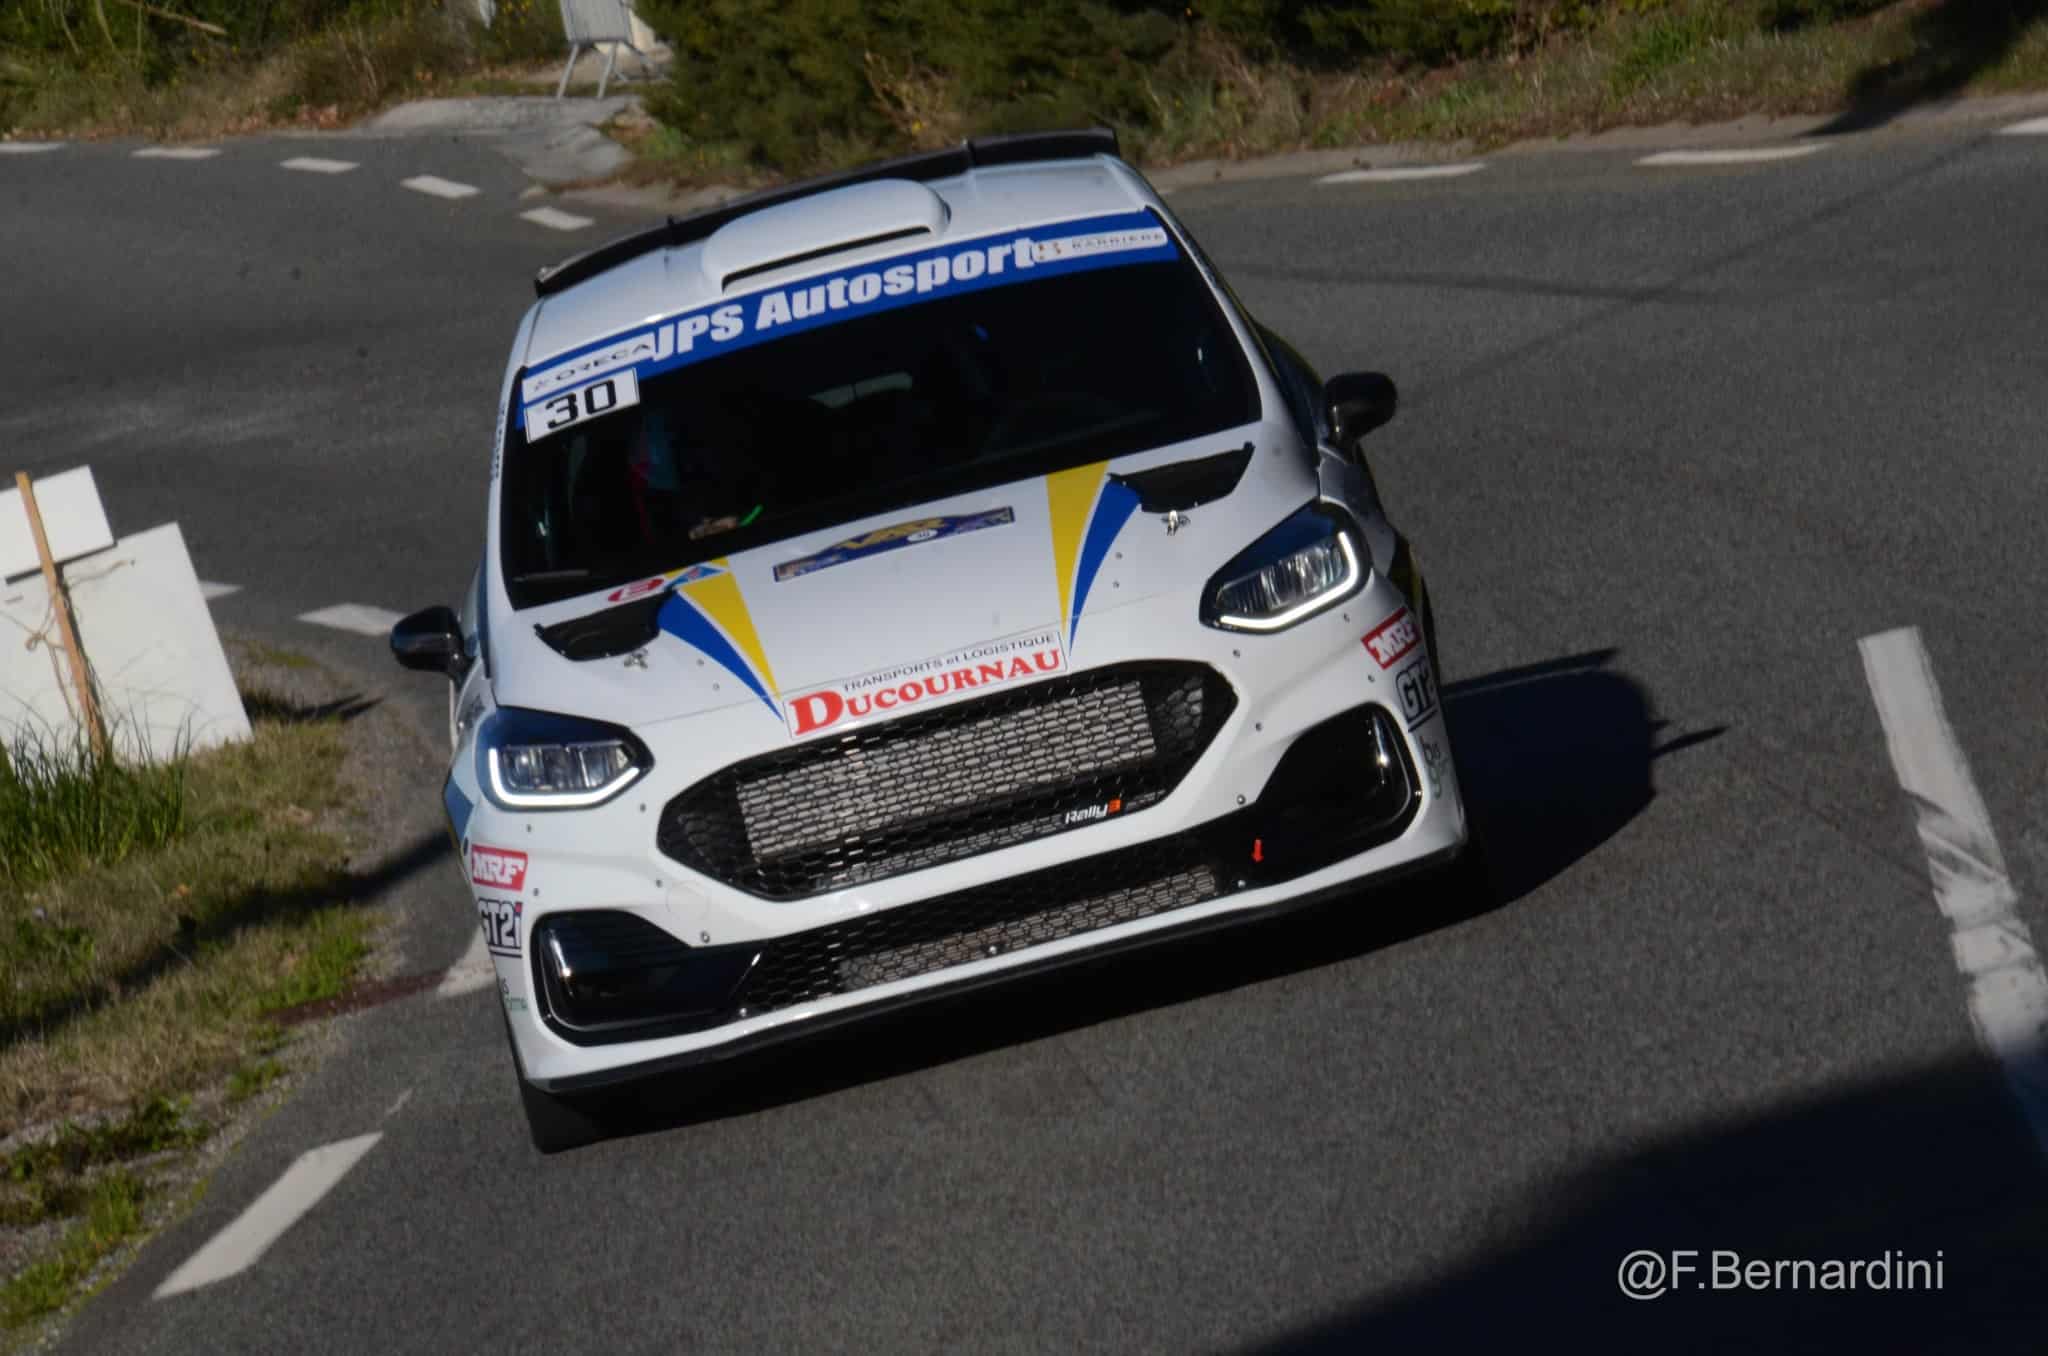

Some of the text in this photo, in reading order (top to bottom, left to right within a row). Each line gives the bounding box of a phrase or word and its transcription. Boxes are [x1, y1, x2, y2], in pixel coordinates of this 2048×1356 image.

[651, 237, 1035, 362] JPS Autosport
[545, 379, 617, 429] 30
[842, 659, 943, 692] TRANSPORTS
[963, 634, 1055, 663] LOGISTIQUE
[473, 852, 525, 885] MRF
